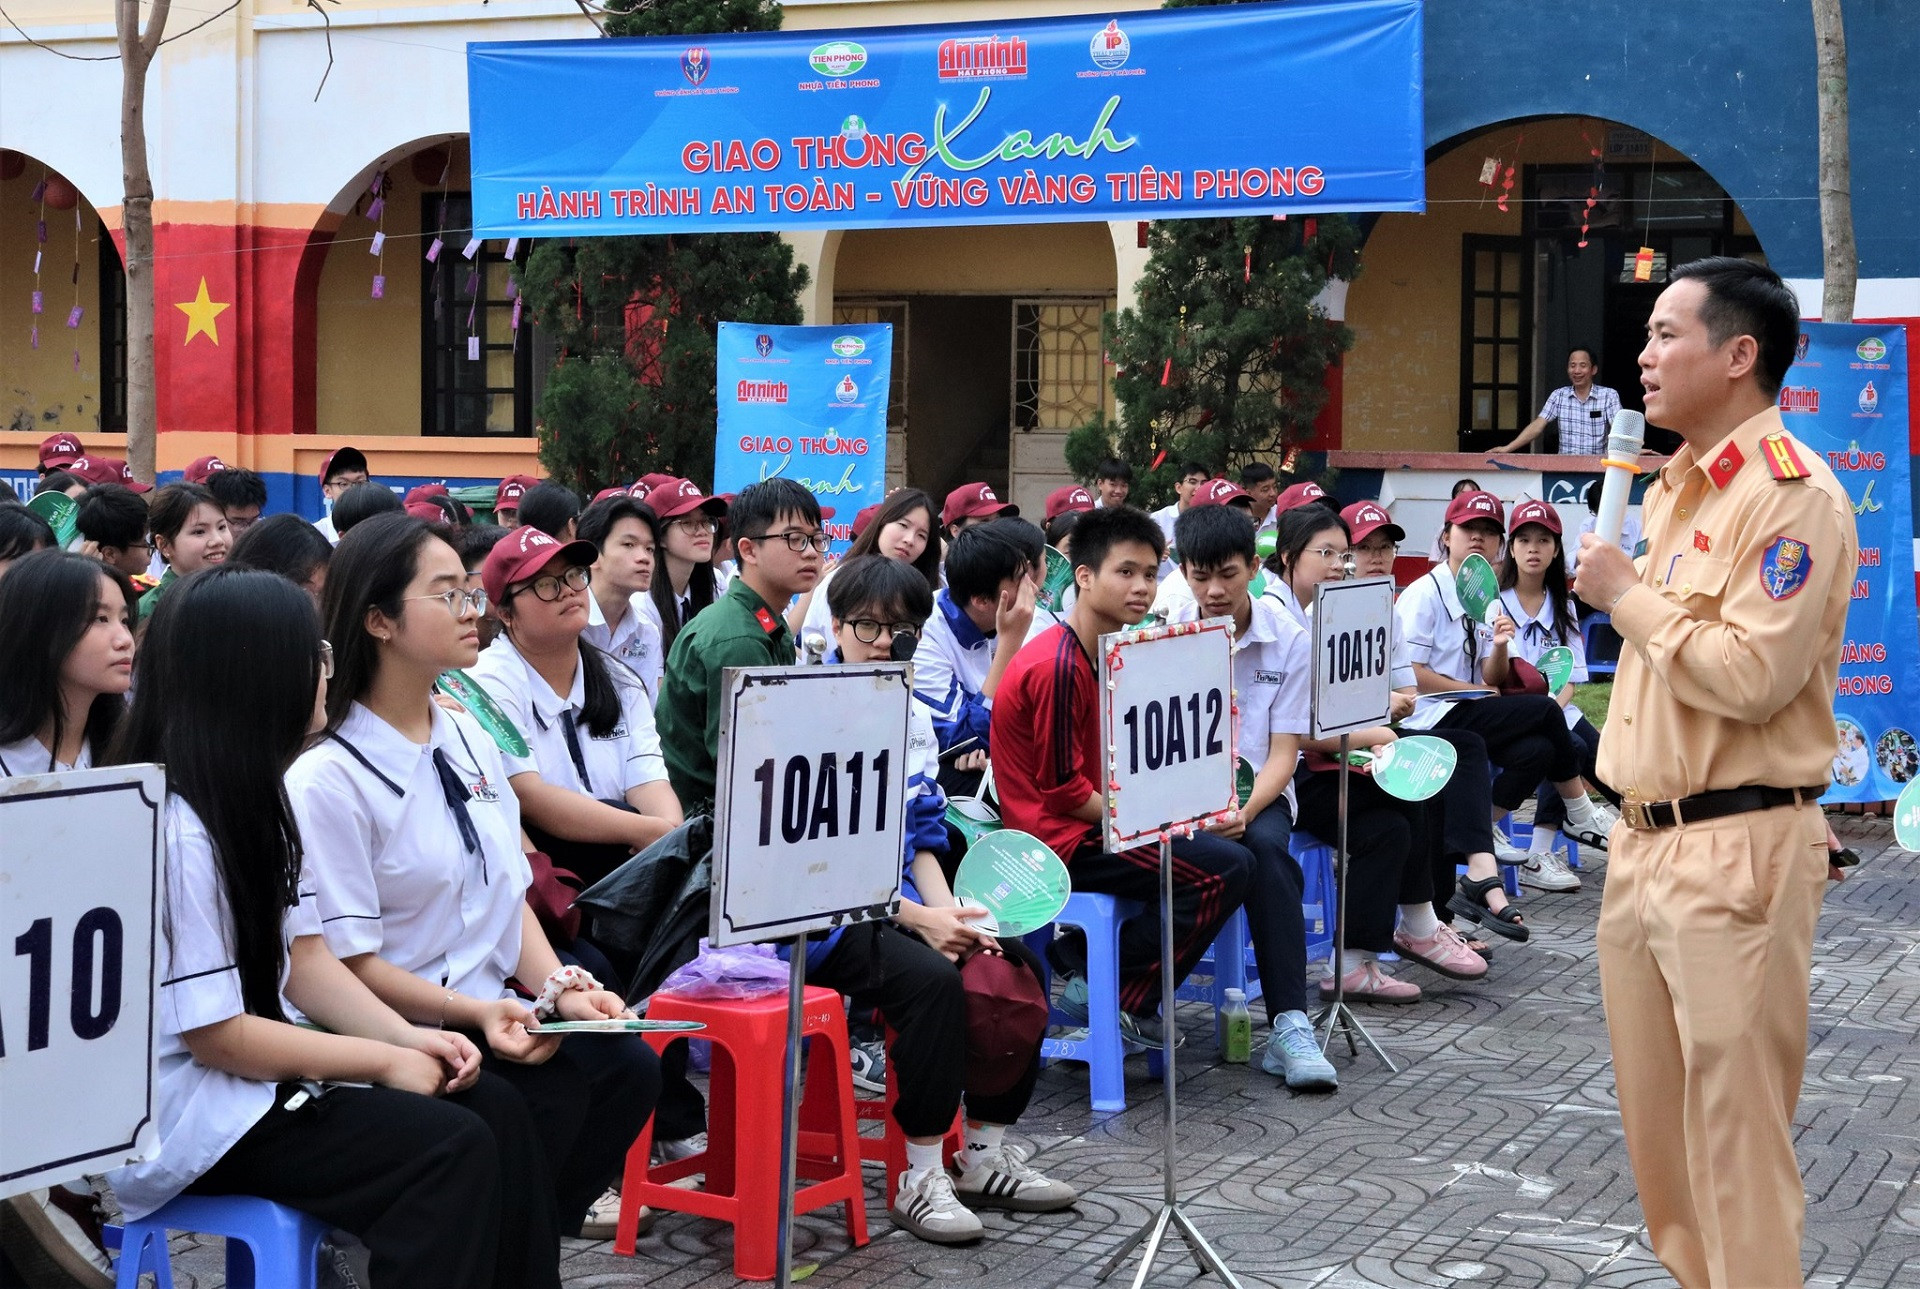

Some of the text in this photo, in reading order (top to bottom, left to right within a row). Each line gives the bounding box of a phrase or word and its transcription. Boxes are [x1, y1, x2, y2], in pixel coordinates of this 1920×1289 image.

[834, 54, 863, 62] PHONG
[850, 79, 879, 88] PHONG
[682, 139, 781, 173] GIAO
[901, 86, 1136, 188] Xanh
[517, 186, 600, 219] HÀNH
[610, 182, 701, 216] TRÌNH
[710, 185, 755, 213] AN
[764, 177, 854, 212] TOÀN
[891, 173, 988, 208] VỮNG
[998, 170, 1096, 205] VÀNG
[1106, 165, 1181, 202] TIÊN
[1194, 166, 1325, 199] PHONG
[739, 436, 793, 453] GIAO
[1765, 566, 1802, 583] CSGT
[1327, 626, 1386, 684] 10A13
[1838, 676, 1892, 696] HONG
[1123, 687, 1223, 775] 10A12
[754, 749, 890, 847] 10A11
[0, 906, 123, 1057] 10
